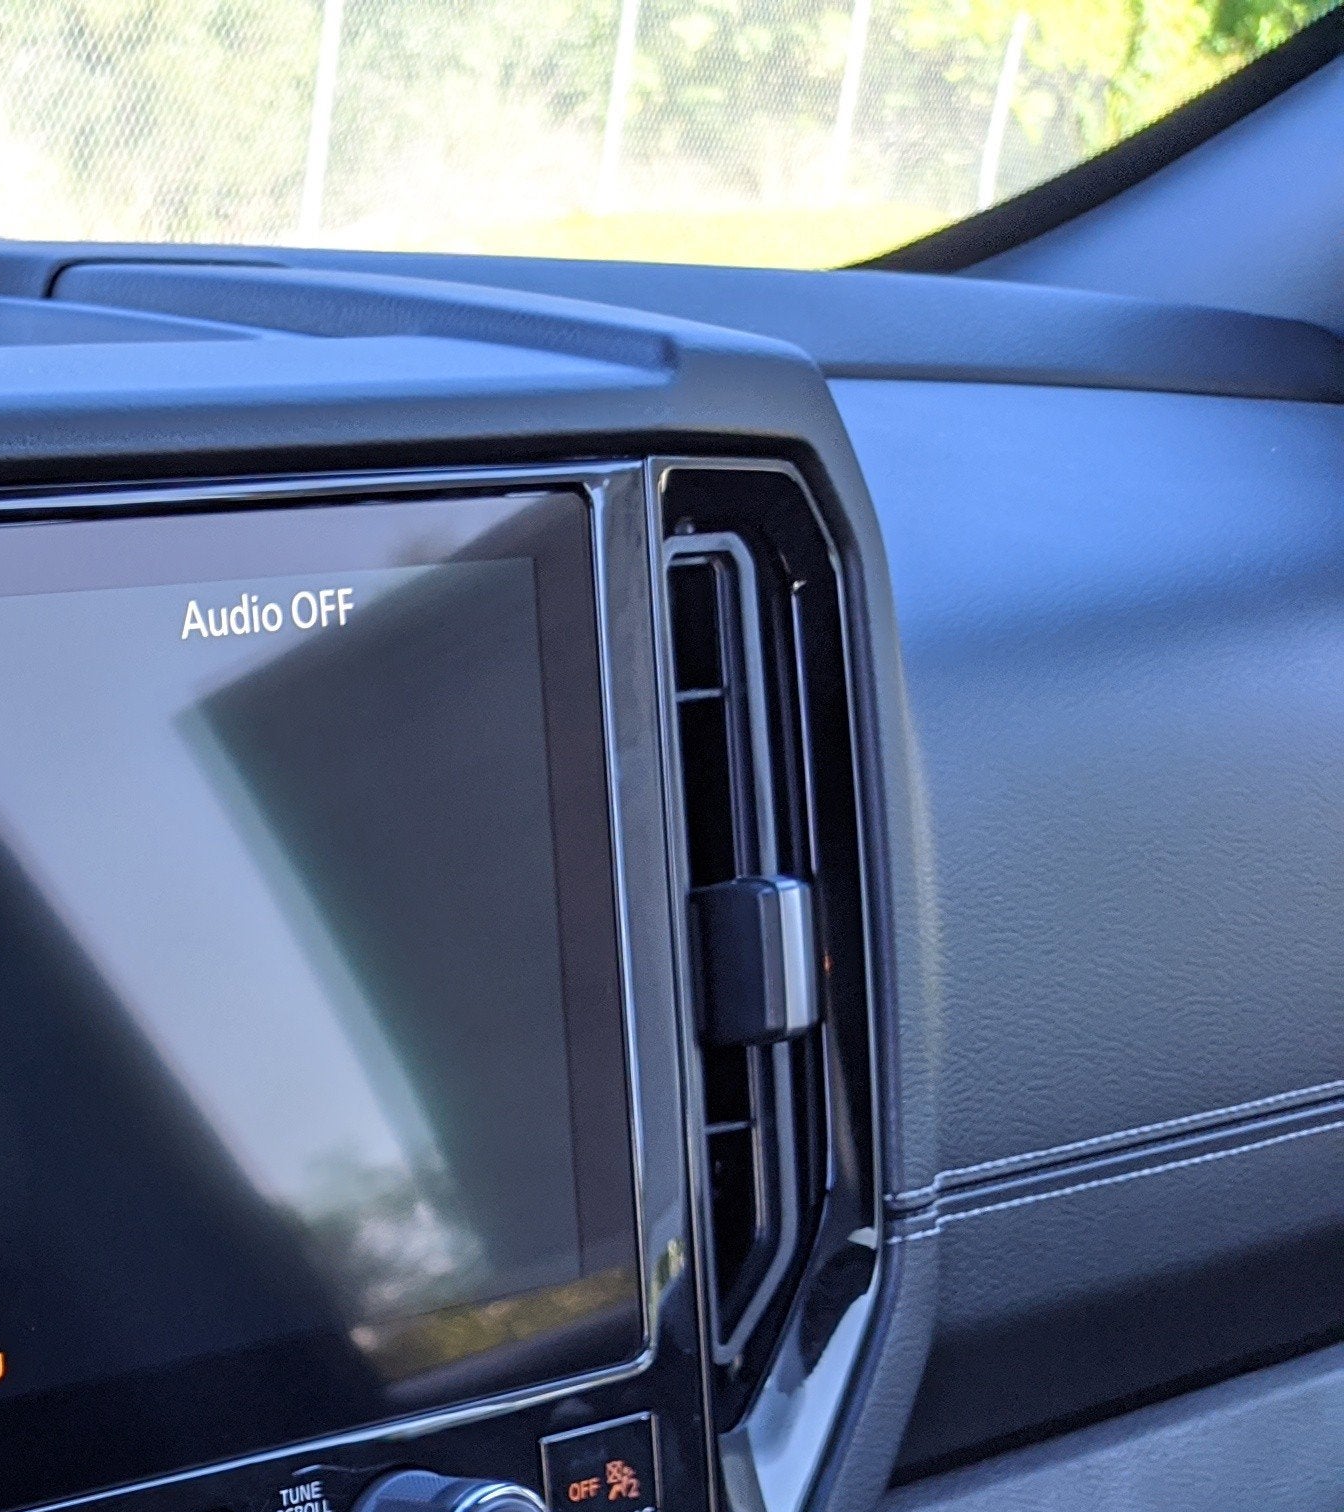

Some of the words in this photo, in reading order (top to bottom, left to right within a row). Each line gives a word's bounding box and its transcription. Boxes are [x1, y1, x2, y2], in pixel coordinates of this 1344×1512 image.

[181, 595, 283, 639] Audio
[291, 587, 355, 628] OFF
[279, 1481, 324, 1507] TUNE
[568, 1477, 601, 1502] OFF
